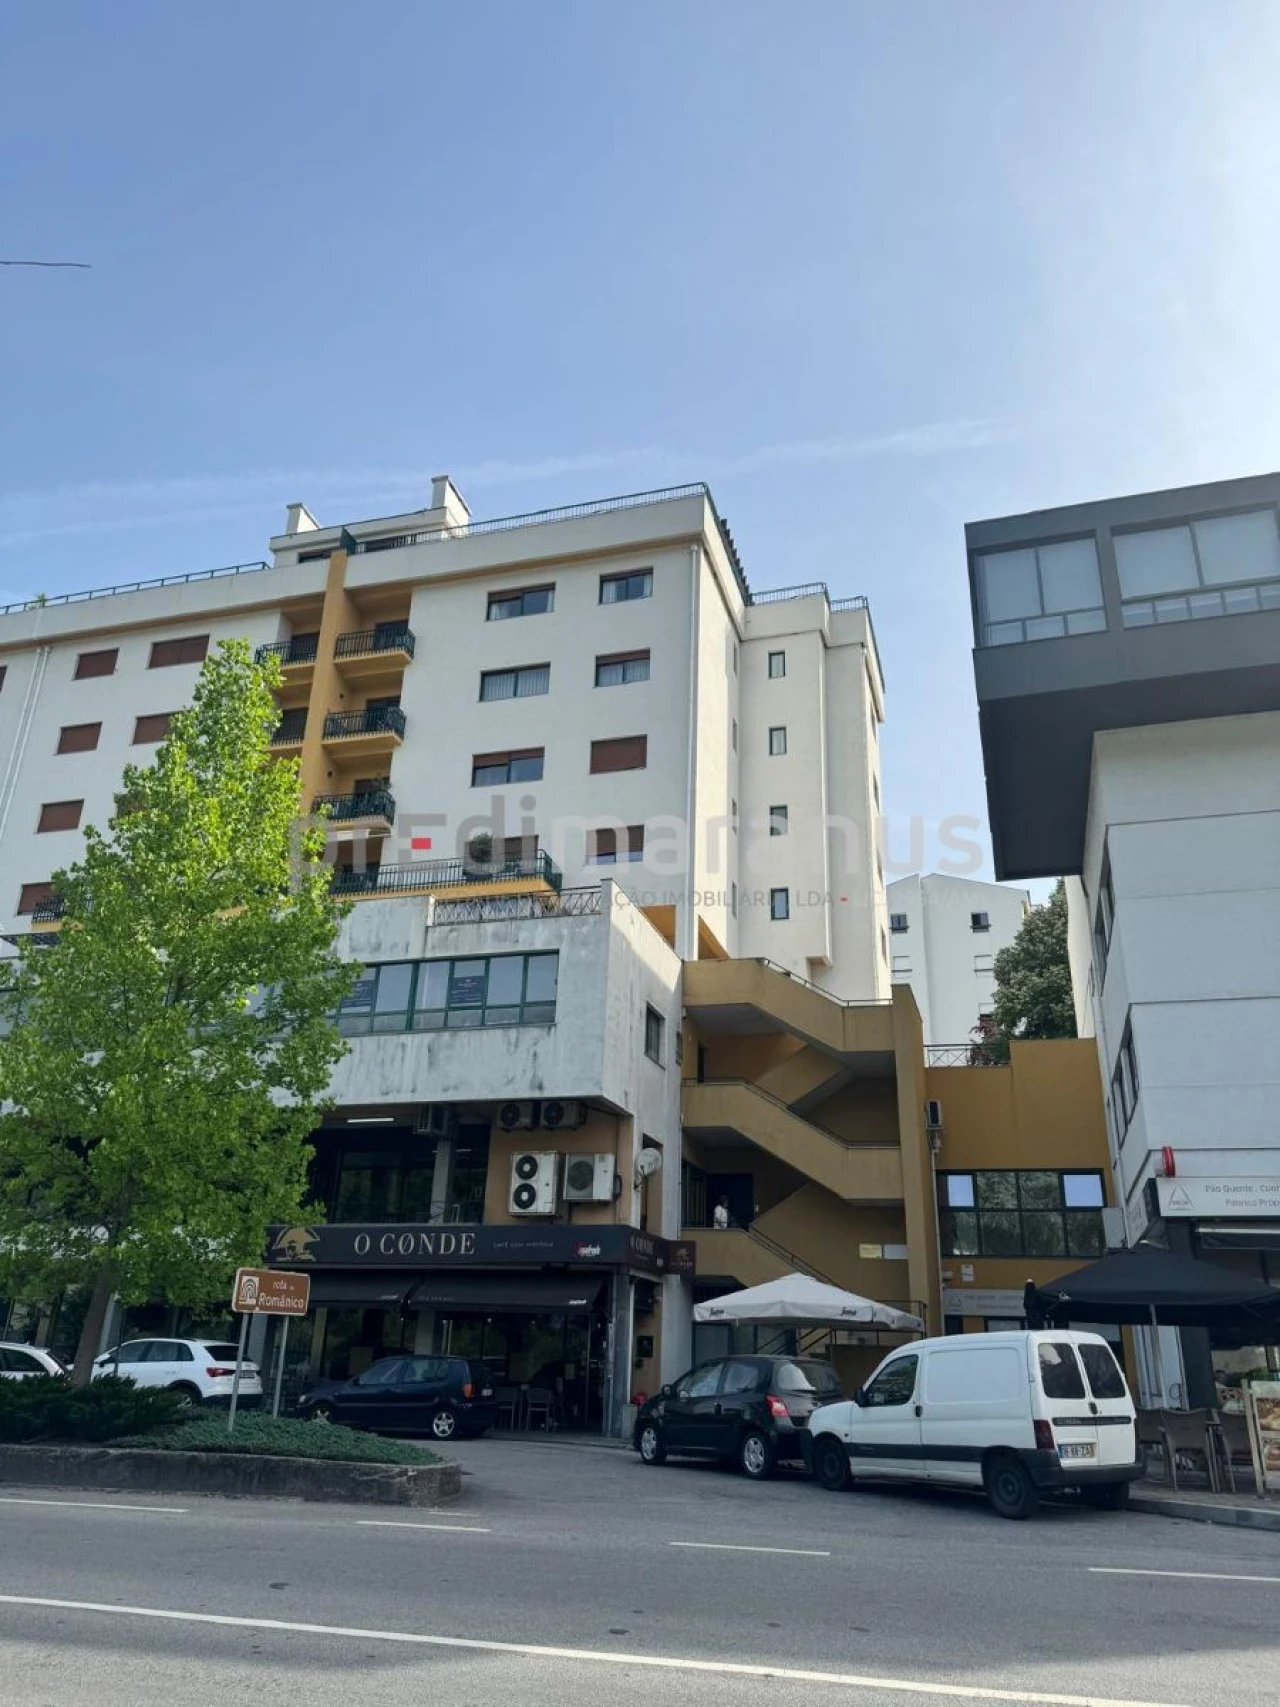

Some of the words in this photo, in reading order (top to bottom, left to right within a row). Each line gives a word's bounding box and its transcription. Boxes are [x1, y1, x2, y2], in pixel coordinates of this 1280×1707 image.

[353, 1232, 371, 1256] O
[273, 1279, 288, 1291] rota
[258, 1292, 305, 1309] Românico
